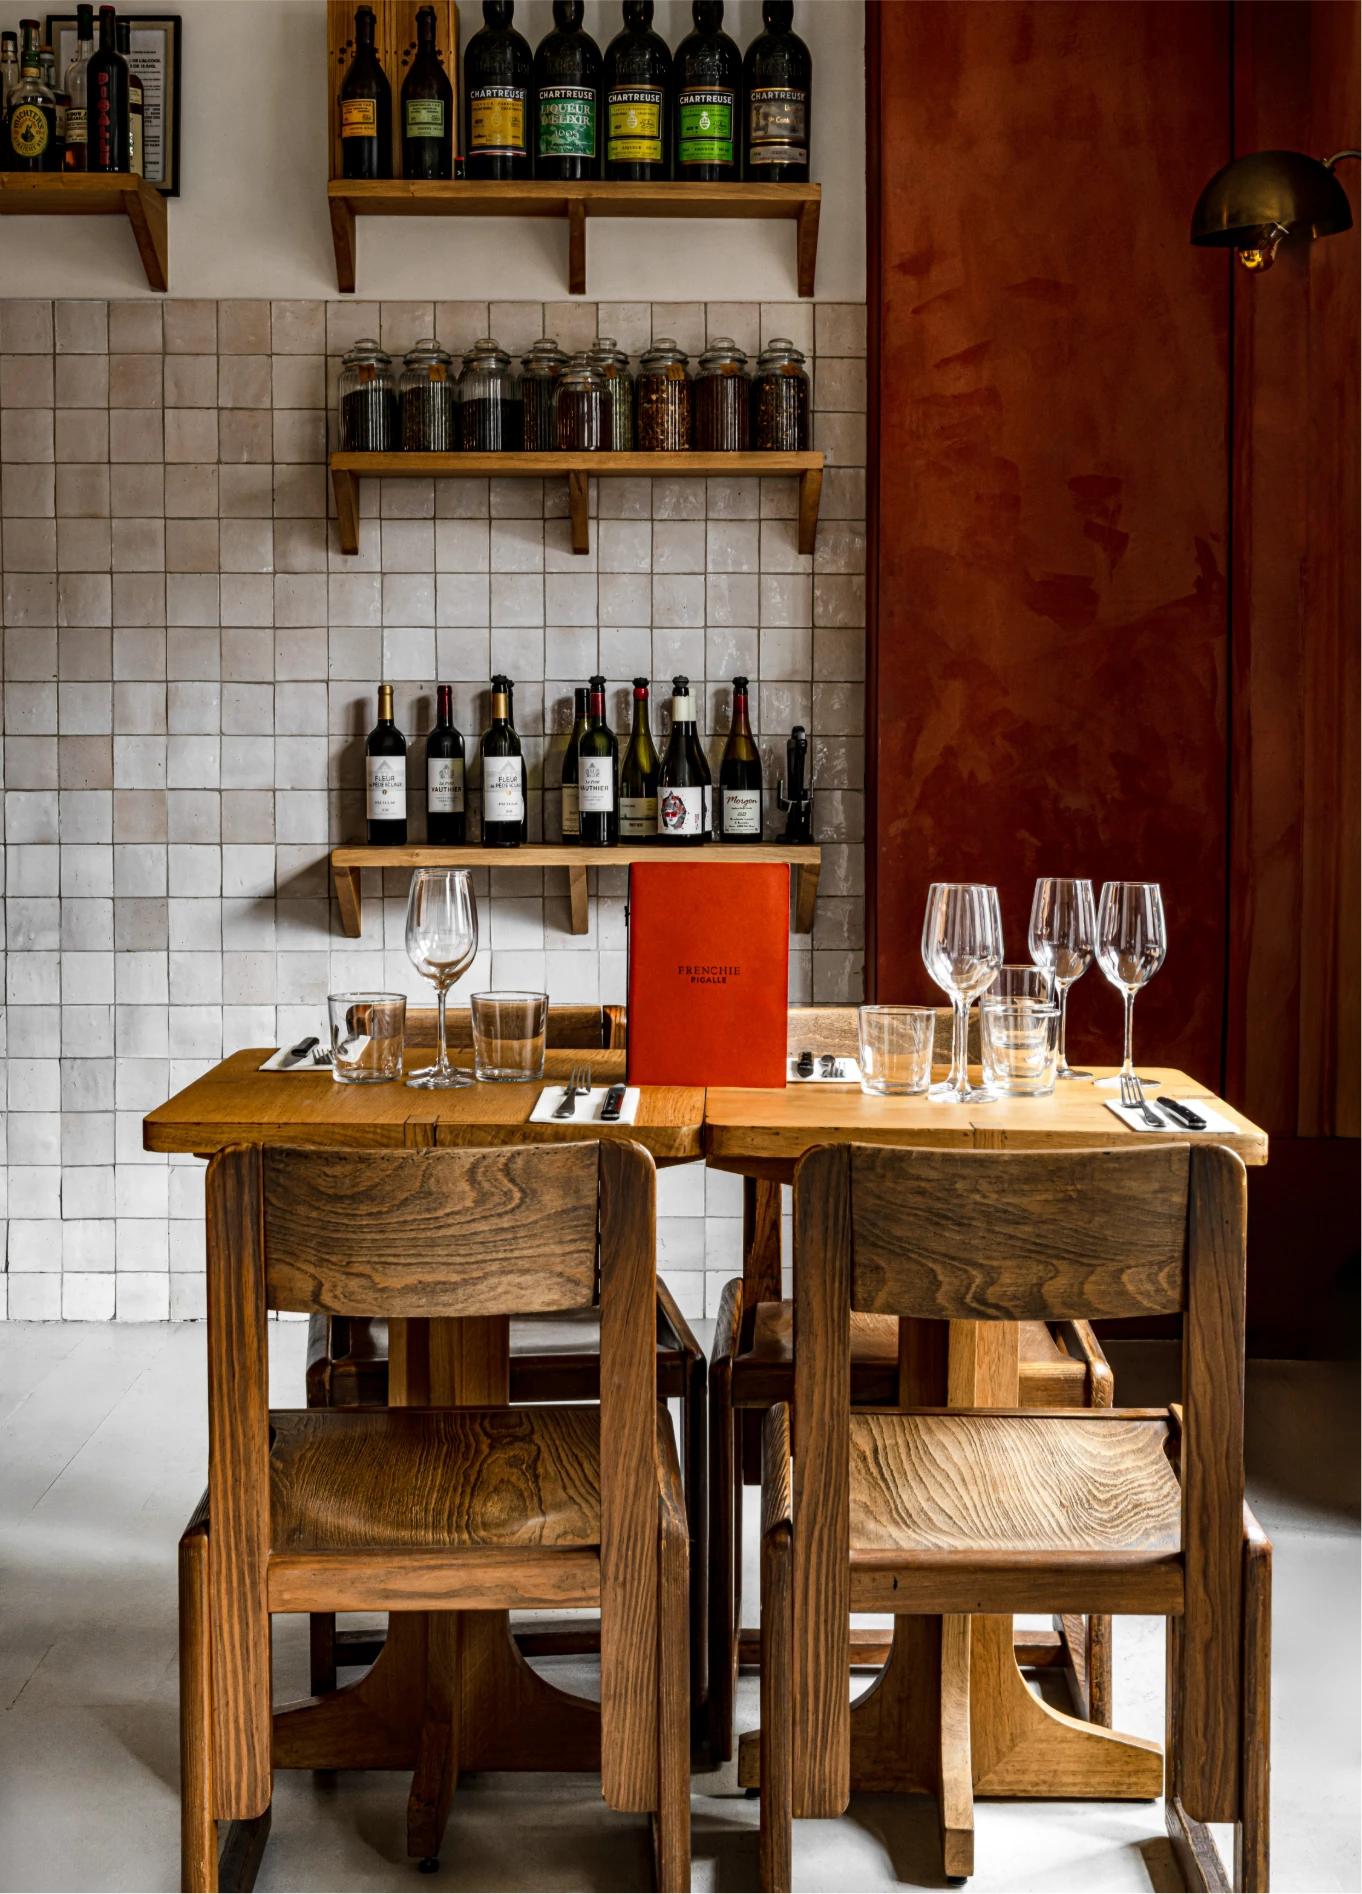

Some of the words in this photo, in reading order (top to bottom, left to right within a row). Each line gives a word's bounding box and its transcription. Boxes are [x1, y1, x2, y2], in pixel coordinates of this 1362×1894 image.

[470, 89, 525, 100] CHARTREUSE
[539, 89, 593, 100] CHARTREUSE
[608, 93, 661, 103] CHARTREUSE
[679, 95, 732, 104] CHARTREUSE
[750, 91, 805, 102] CHARTREUSE
[540, 102, 591, 115] LIQUEUR
[98, 71, 111, 166] PIGALLE
[726, 795, 758, 807] Morgon
[677, 965, 741, 976] FRENCHIE
[690, 976, 727, 984] PIGALLE
